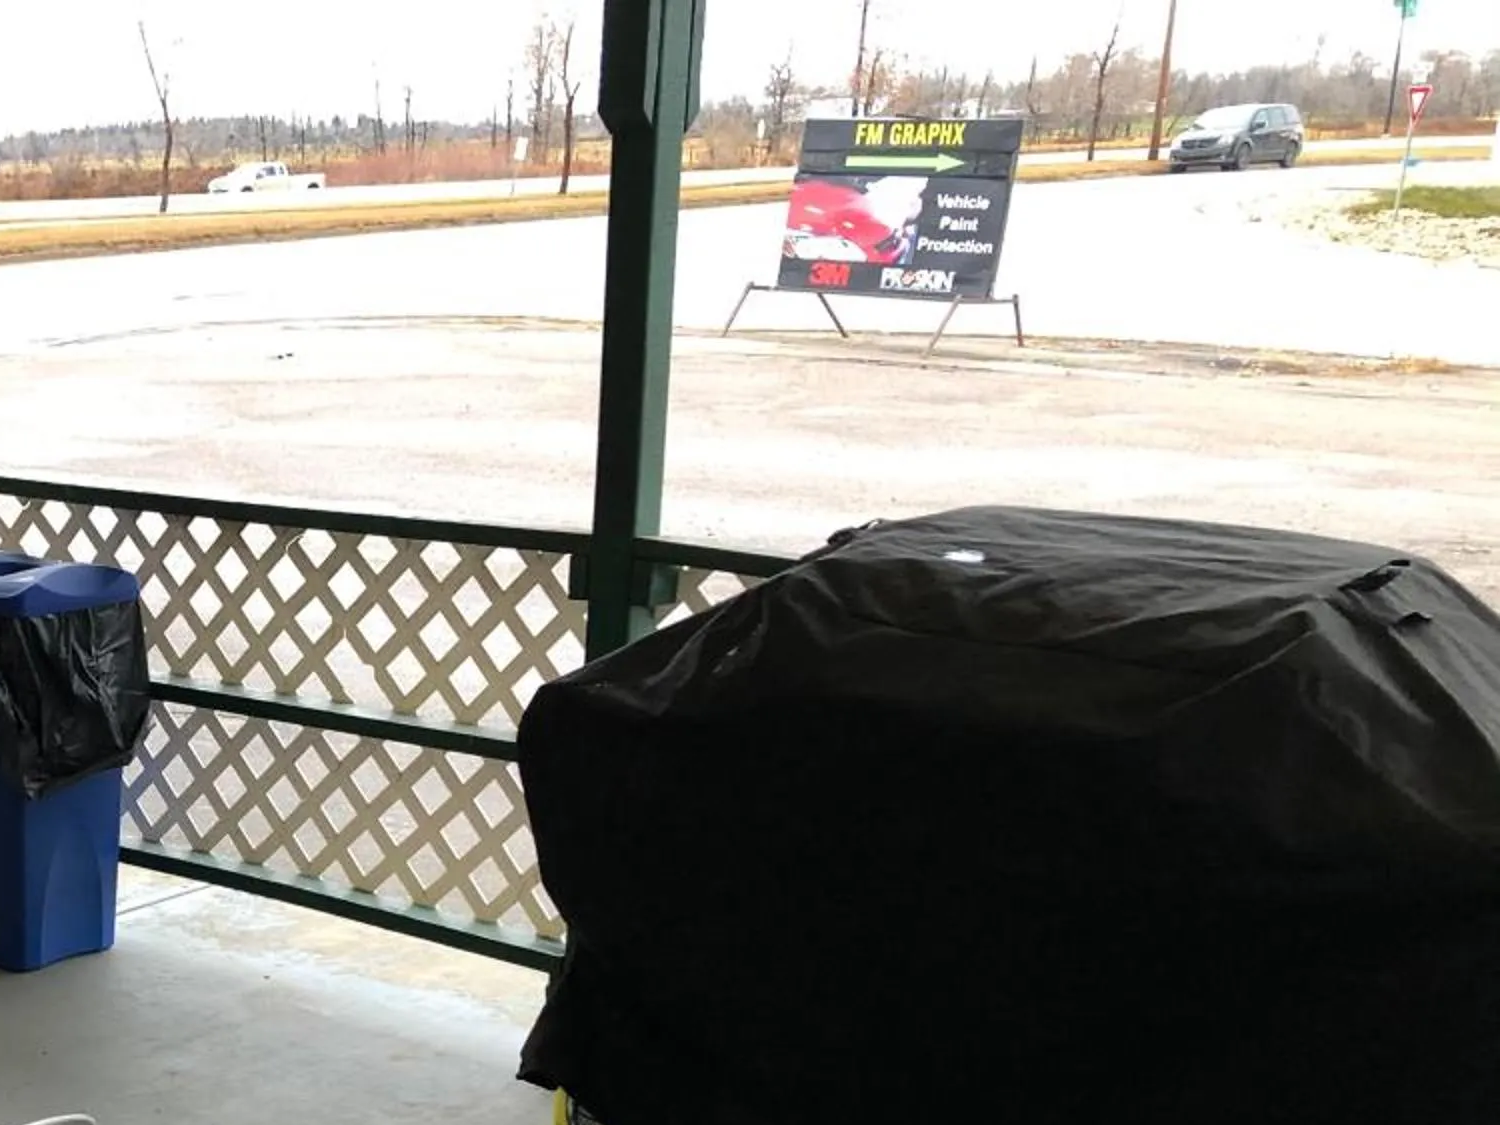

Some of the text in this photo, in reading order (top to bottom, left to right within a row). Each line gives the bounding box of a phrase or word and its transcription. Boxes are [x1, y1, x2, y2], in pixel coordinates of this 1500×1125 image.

[855, 122, 966, 146] FM GRAPHX
[937, 193, 991, 210] Vehicle
[939, 215, 979, 232] Paint
[916, 236, 994, 254] Protection
[809, 262, 850, 287] 3M
